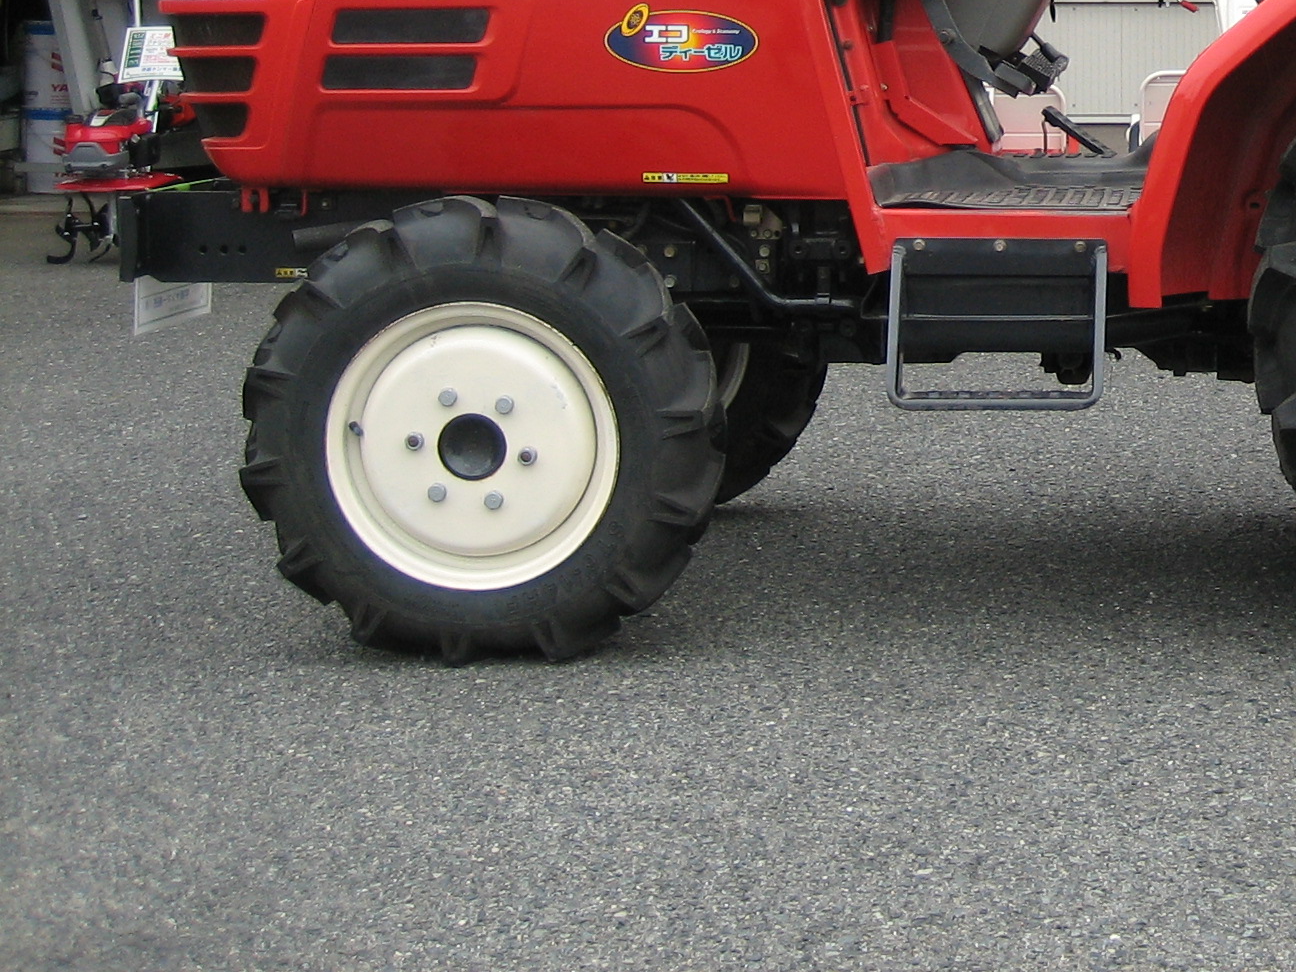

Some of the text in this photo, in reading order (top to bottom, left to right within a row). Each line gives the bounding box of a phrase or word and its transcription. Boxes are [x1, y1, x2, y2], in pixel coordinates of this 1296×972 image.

[644, 24, 690, 44] エコ
[660, 43, 743, 61] ディーゼル
